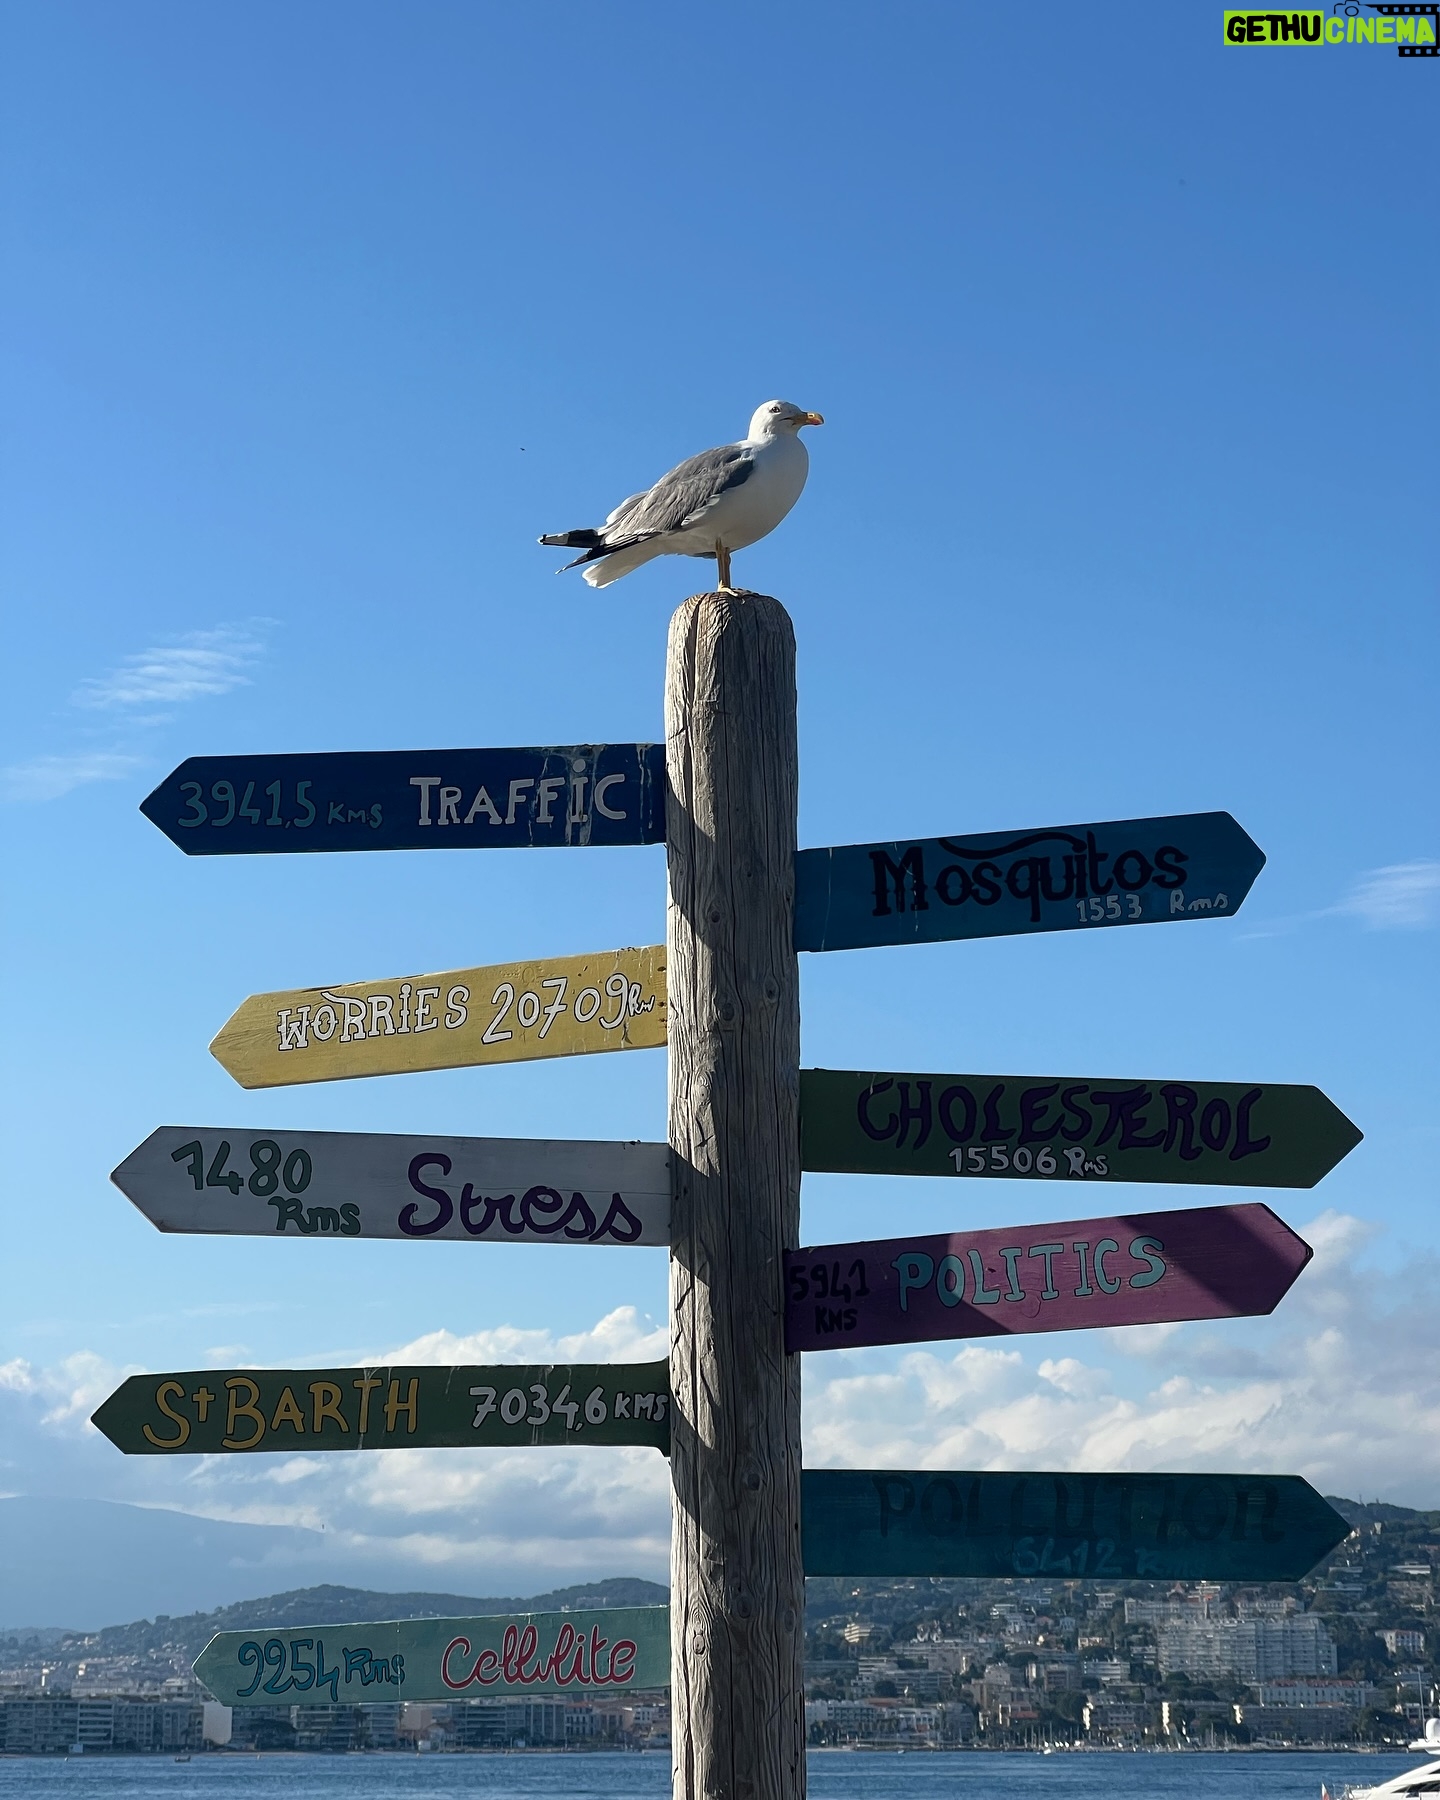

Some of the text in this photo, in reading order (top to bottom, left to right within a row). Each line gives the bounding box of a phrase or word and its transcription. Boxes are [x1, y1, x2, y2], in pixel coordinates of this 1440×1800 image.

[869, 831, 1189, 922] Mosquitos
[1075, 893, 1143, 923] 1553
[277, 982, 471, 1051] WORRIES
[857, 1078, 1272, 1161] CHOLESTEROL
[948, 1145, 1058, 1175] 15506
[398, 1152, 643, 1243] Stress
[789, 1234, 1166, 1312] 5941 POLITICS
[221, 1377, 419, 1450] BARTH
[469, 1383, 608, 1432] 7034,6
[441, 1622, 638, 1691] Cellulite
